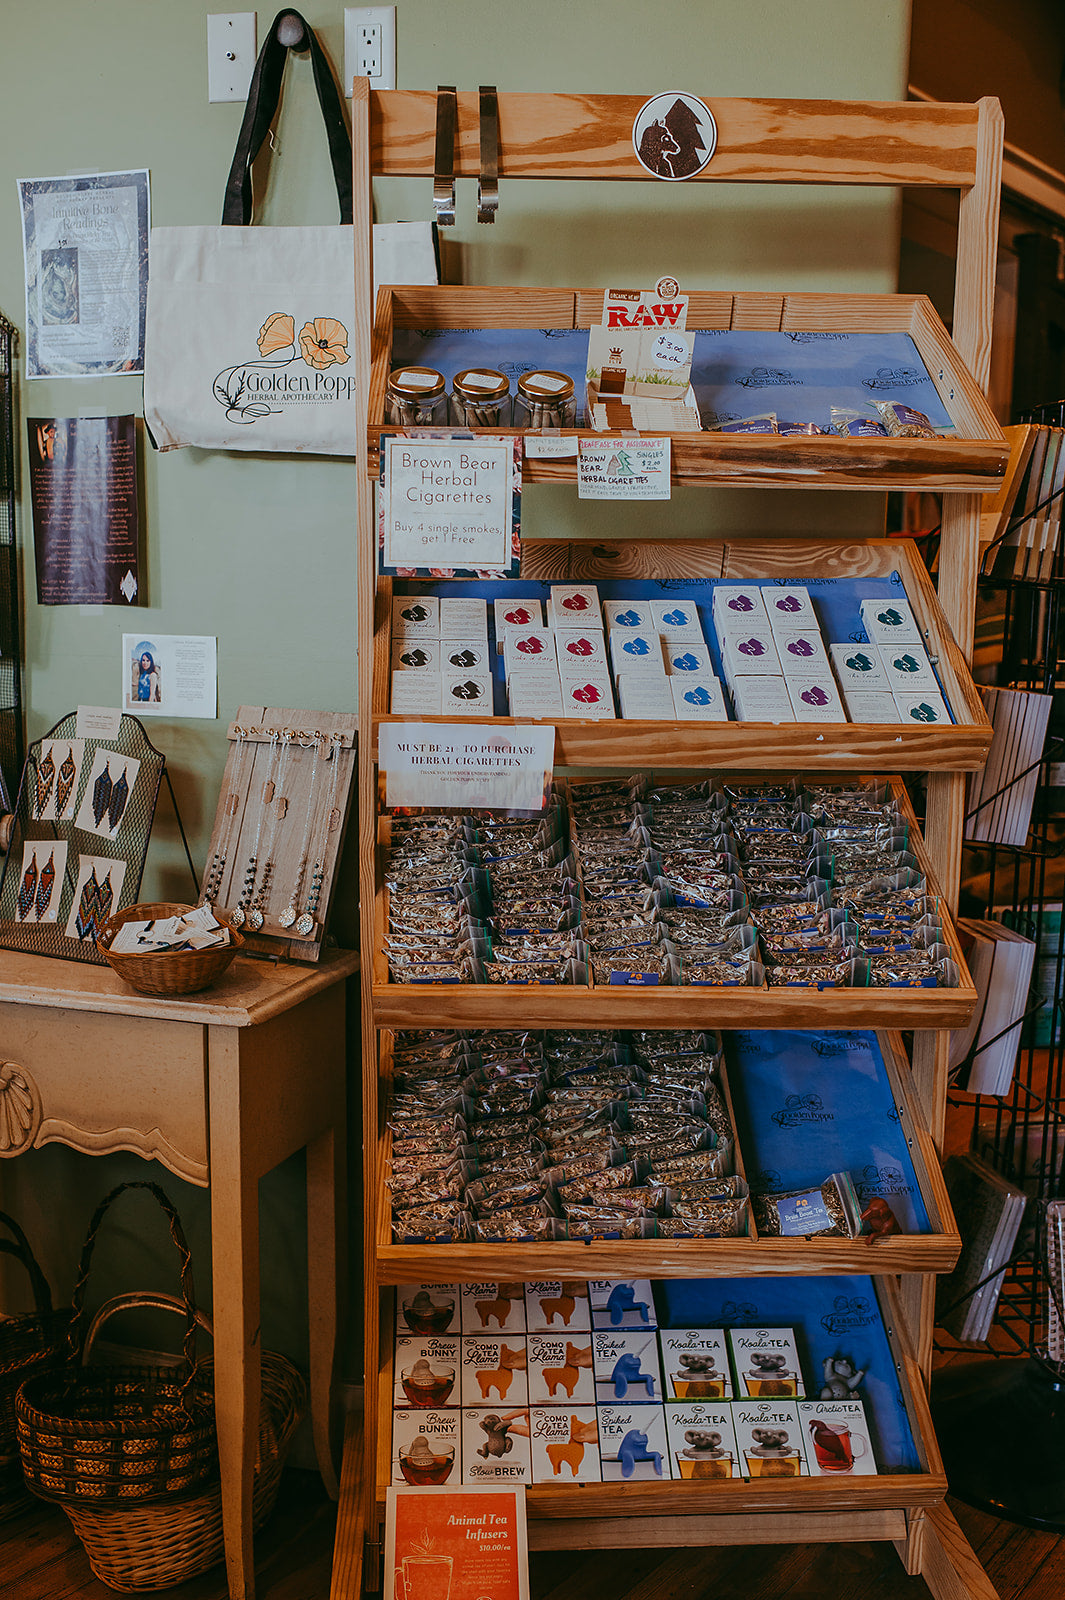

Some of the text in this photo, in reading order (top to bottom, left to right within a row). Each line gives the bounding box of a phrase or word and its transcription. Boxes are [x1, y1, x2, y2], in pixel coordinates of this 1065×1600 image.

[52, 204, 119, 218] Intuitive Bone
[63, 218, 108, 231] Readings
[607, 304, 685, 327] RAW
[658, 336, 684, 353] $3.00
[656, 352, 681, 363] each
[246, 372, 357, 400] Golden Popp
[580, 440, 597, 448] PLEASE
[626, 440, 662, 448] ASSISTANCE
[402, 452, 496, 470] Brown Bear
[421, 470, 477, 486] Herbal
[608, 476, 649, 485] CIGARETTES
[406, 487, 492, 505] Cigarettes
[395, 521, 413, 533] Buy
[428, 522, 458, 535] single
[422, 534, 475, 544] get 1 Free
[398, 744, 425, 752] MUST
[429, 744, 442, 752] BE
[481, 745, 536, 754] PURCHASE
[411, 756, 521, 766] HERBAL CIGARETTES
[463, 1283, 497, 1296] Llama
[527, 1282, 561, 1294] Llama
[428, 1339, 457, 1349] Brew
[596, 1340, 625, 1350] Spiked
[464, 1348, 499, 1365] Llama
[530, 1346, 565, 1363] Llama
[426, 1413, 456, 1424] Brew
[601, 1415, 632, 1426] Spiked
[419, 1425, 455, 1433] BUNNY
[533, 1420, 569, 1438] Llama
[447, 1514, 508, 1526] Animal Tea
[466, 1529, 508, 1541] Infusers
